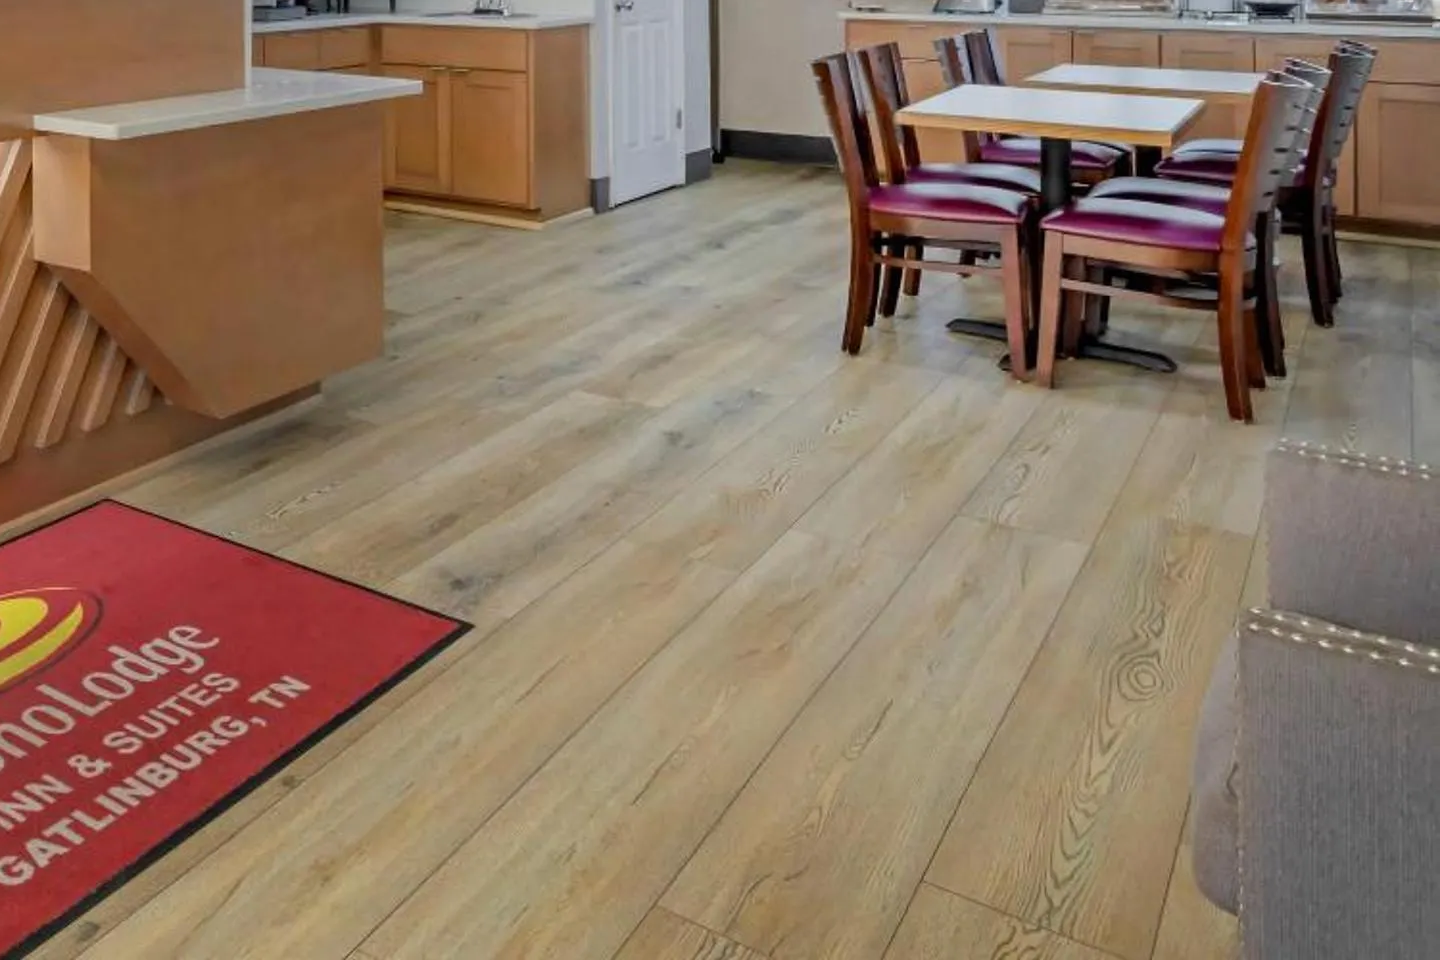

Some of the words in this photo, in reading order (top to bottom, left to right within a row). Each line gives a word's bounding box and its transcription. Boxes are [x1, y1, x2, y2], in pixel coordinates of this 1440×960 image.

[67, 754, 112, 778] &
[103, 673, 241, 754] SUITES
[248, 675, 311, 709] TN
